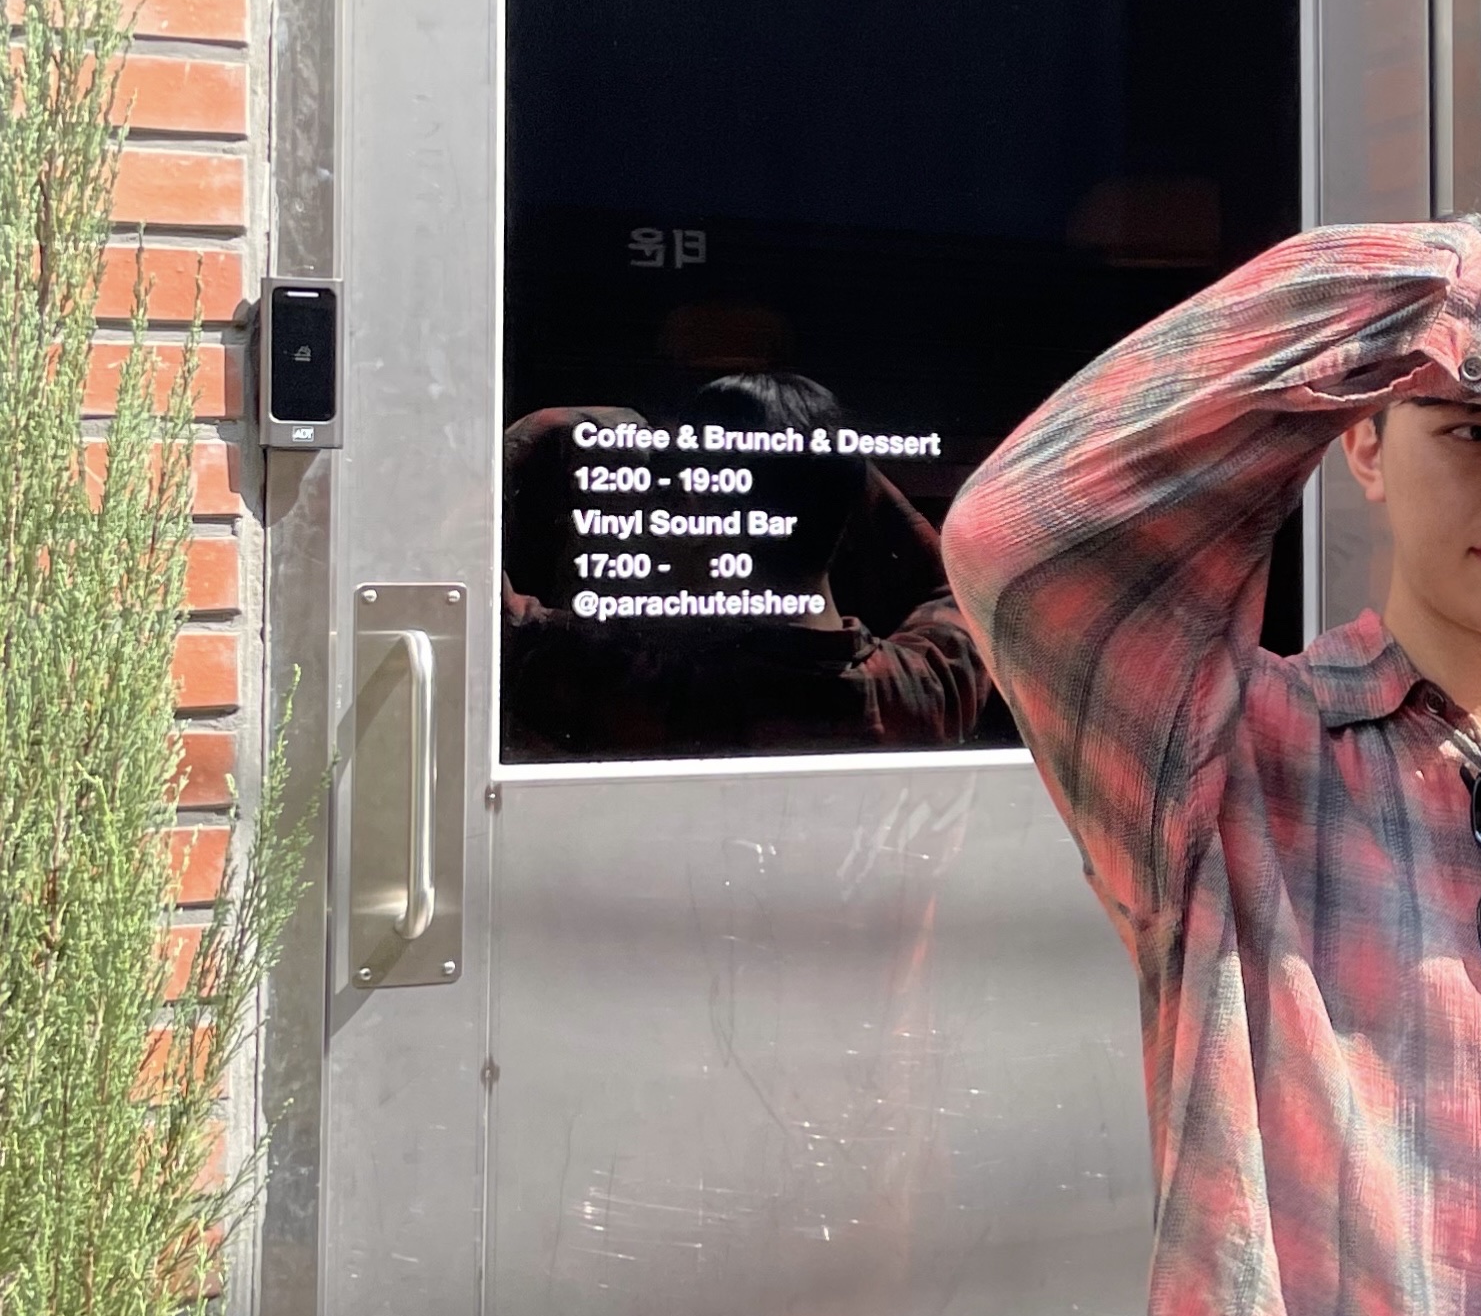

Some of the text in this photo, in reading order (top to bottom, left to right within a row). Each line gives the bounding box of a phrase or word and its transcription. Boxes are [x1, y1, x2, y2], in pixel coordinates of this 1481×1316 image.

[572, 421, 942, 457] Coffee & Brunch & Dessert
[574, 465, 652, 493] 12:00
[678, 467, 753, 494] 19:00
[572, 508, 798, 538] Vinyl Sound Bar
[573, 553, 652, 579] 17:00
[572, 589, 826, 622] @parachuteishere
